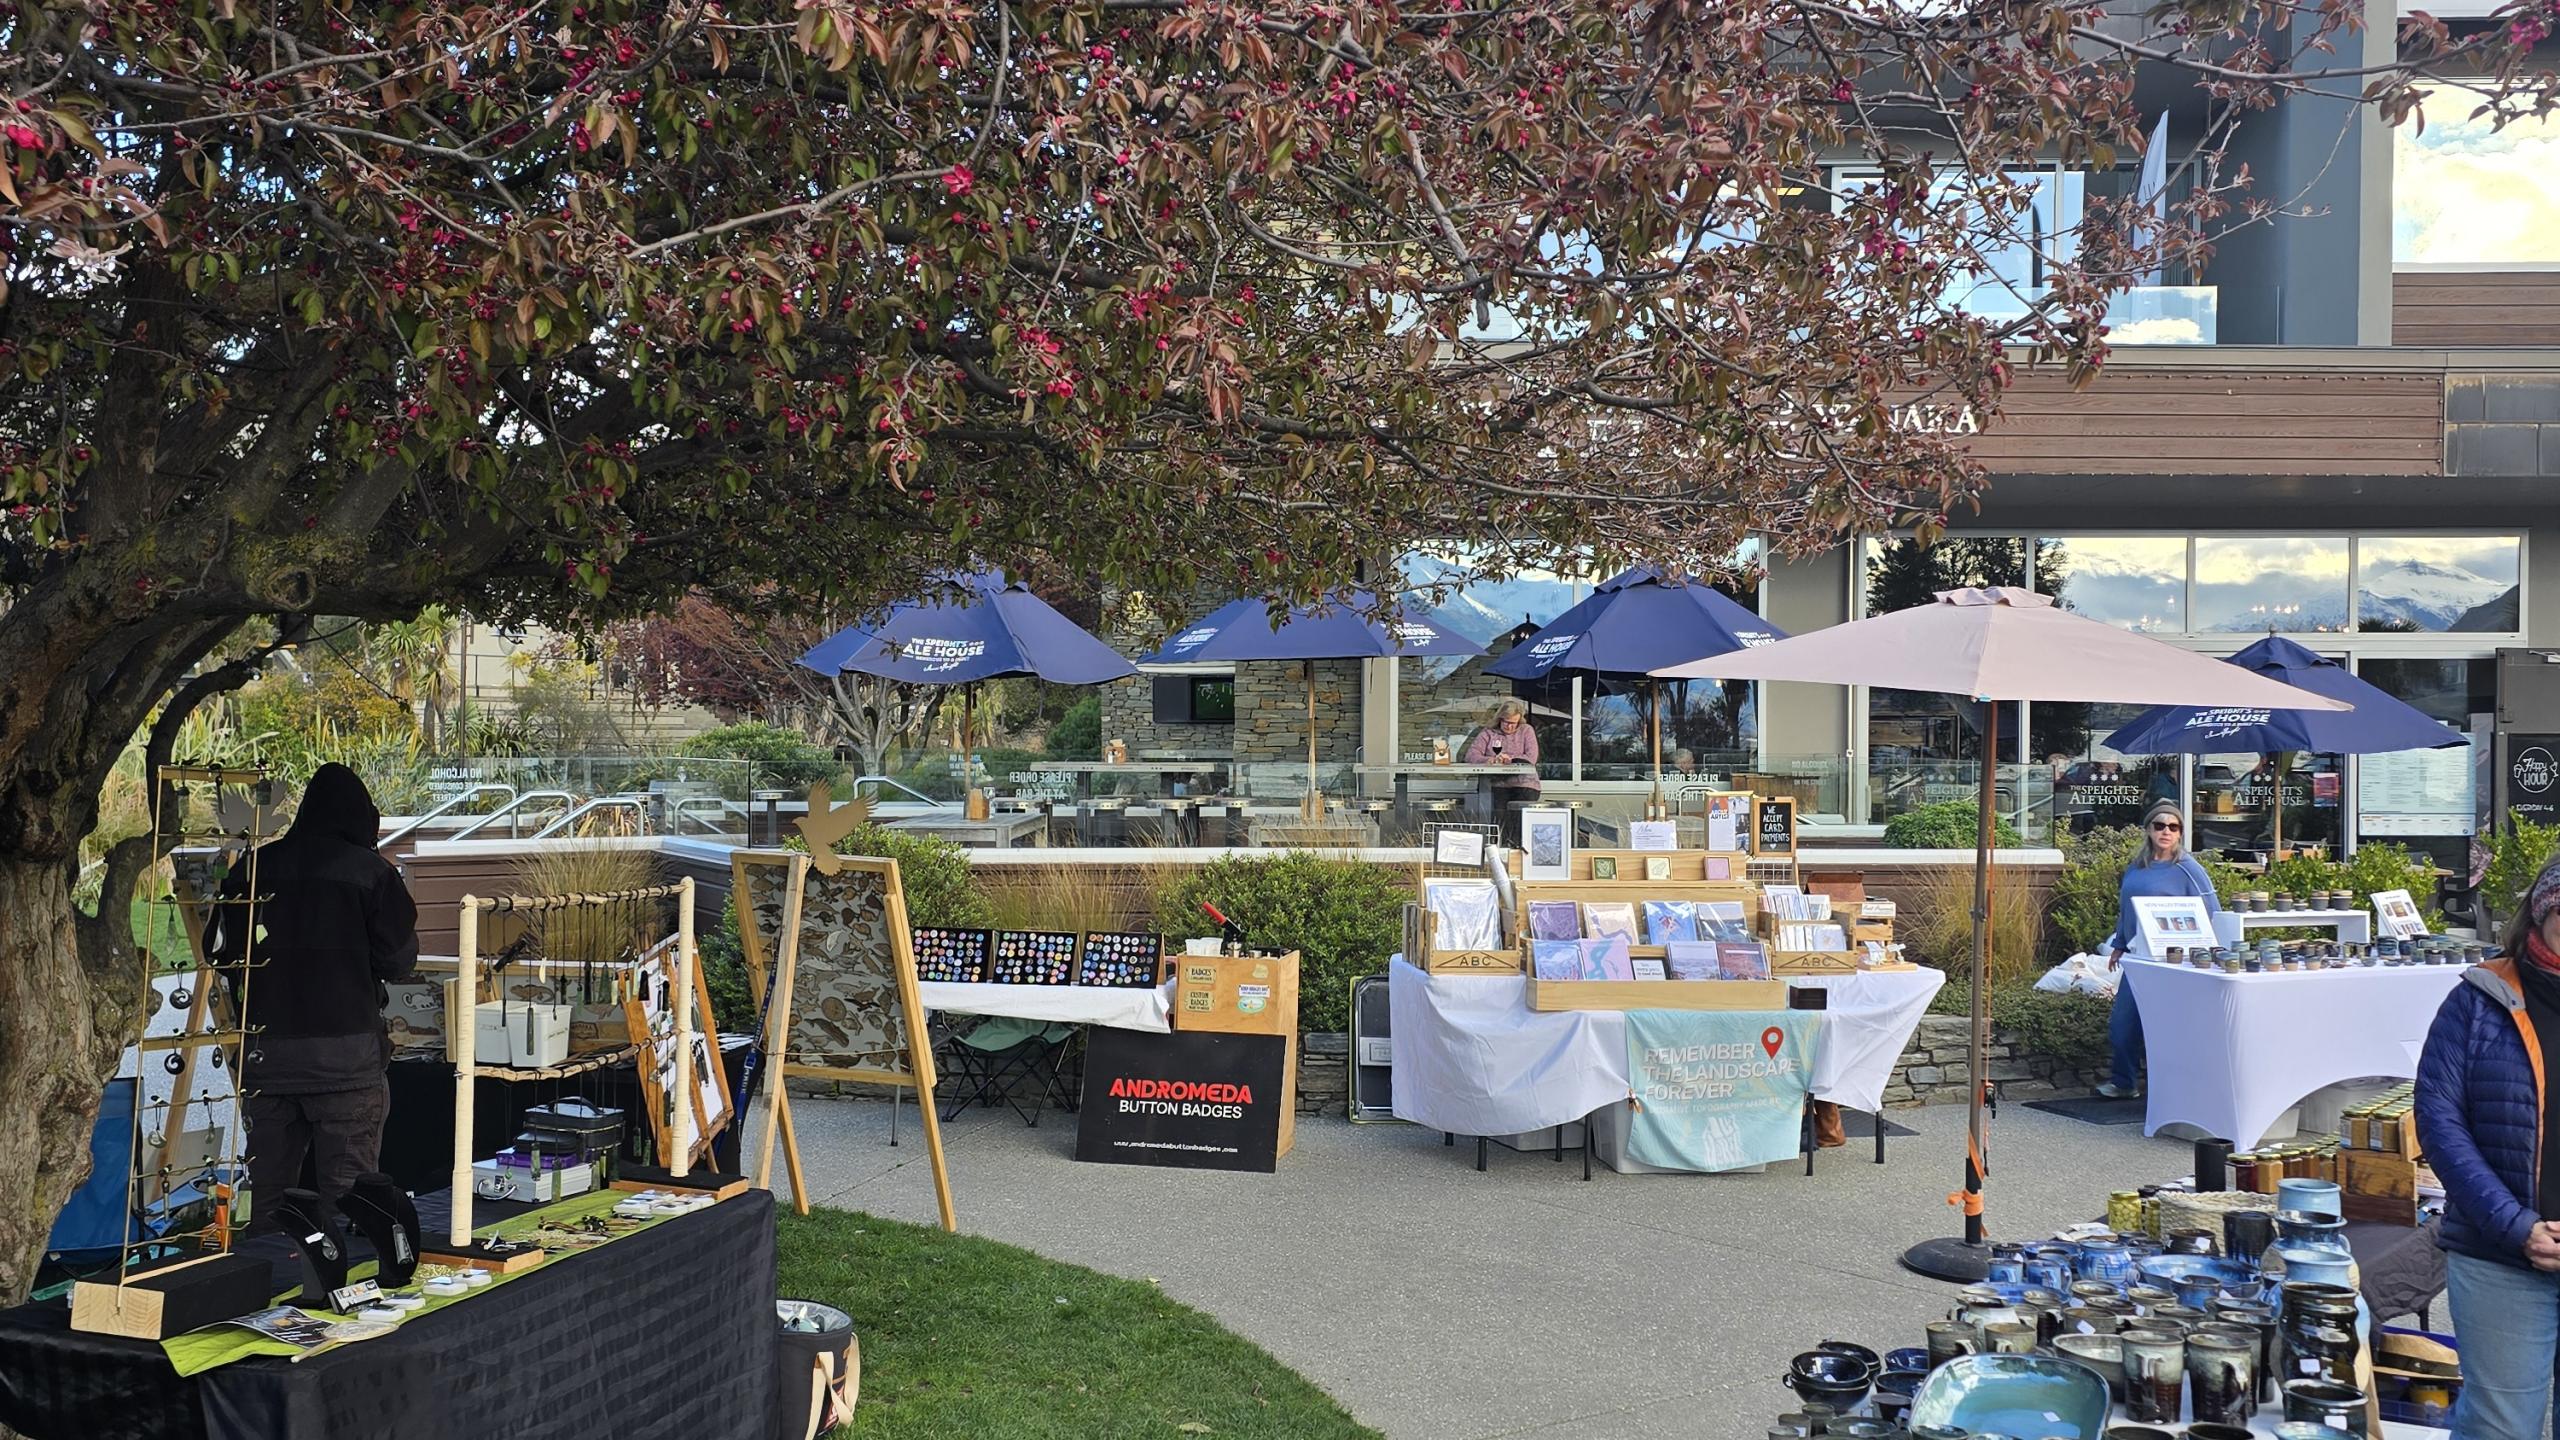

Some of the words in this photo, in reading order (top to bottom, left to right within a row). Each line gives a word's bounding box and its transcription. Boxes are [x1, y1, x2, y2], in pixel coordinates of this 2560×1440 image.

[903, 643, 932, 657] ALE
[934, 645, 985, 658] HOUSE
[2184, 716, 2215, 727] ALE
[2215, 714, 2271, 723] HOUSE
[2523, 772, 2548, 786] HOUR
[2081, 784, 2140, 795] SPEIGHT'S
[2068, 791, 2096, 805] ALE
[2097, 794, 2140, 805] HOUSE
[2233, 791, 2260, 806] ALE
[1766, 805, 1777, 814] WE
[1762, 814, 1784, 823] ACCEPT
[1764, 823, 1784, 832] CARD
[1761, 833, 1791, 842] PAYMENTS
[1460, 956, 1491, 966] ABC
[1801, 957, 1832, 967] ABC
[1644, 1043, 1755, 1064] REMEMBER
[1109, 1078, 1253, 1104] ANDROMEDA
[1645, 1083, 1736, 1101] FOREVER
[1119, 1099, 1178, 1115] BUTTON
[1181, 1103, 1243, 1119] BADGES
[1113, 1140, 1239, 1153] www.andromedabuttonbadges.com
